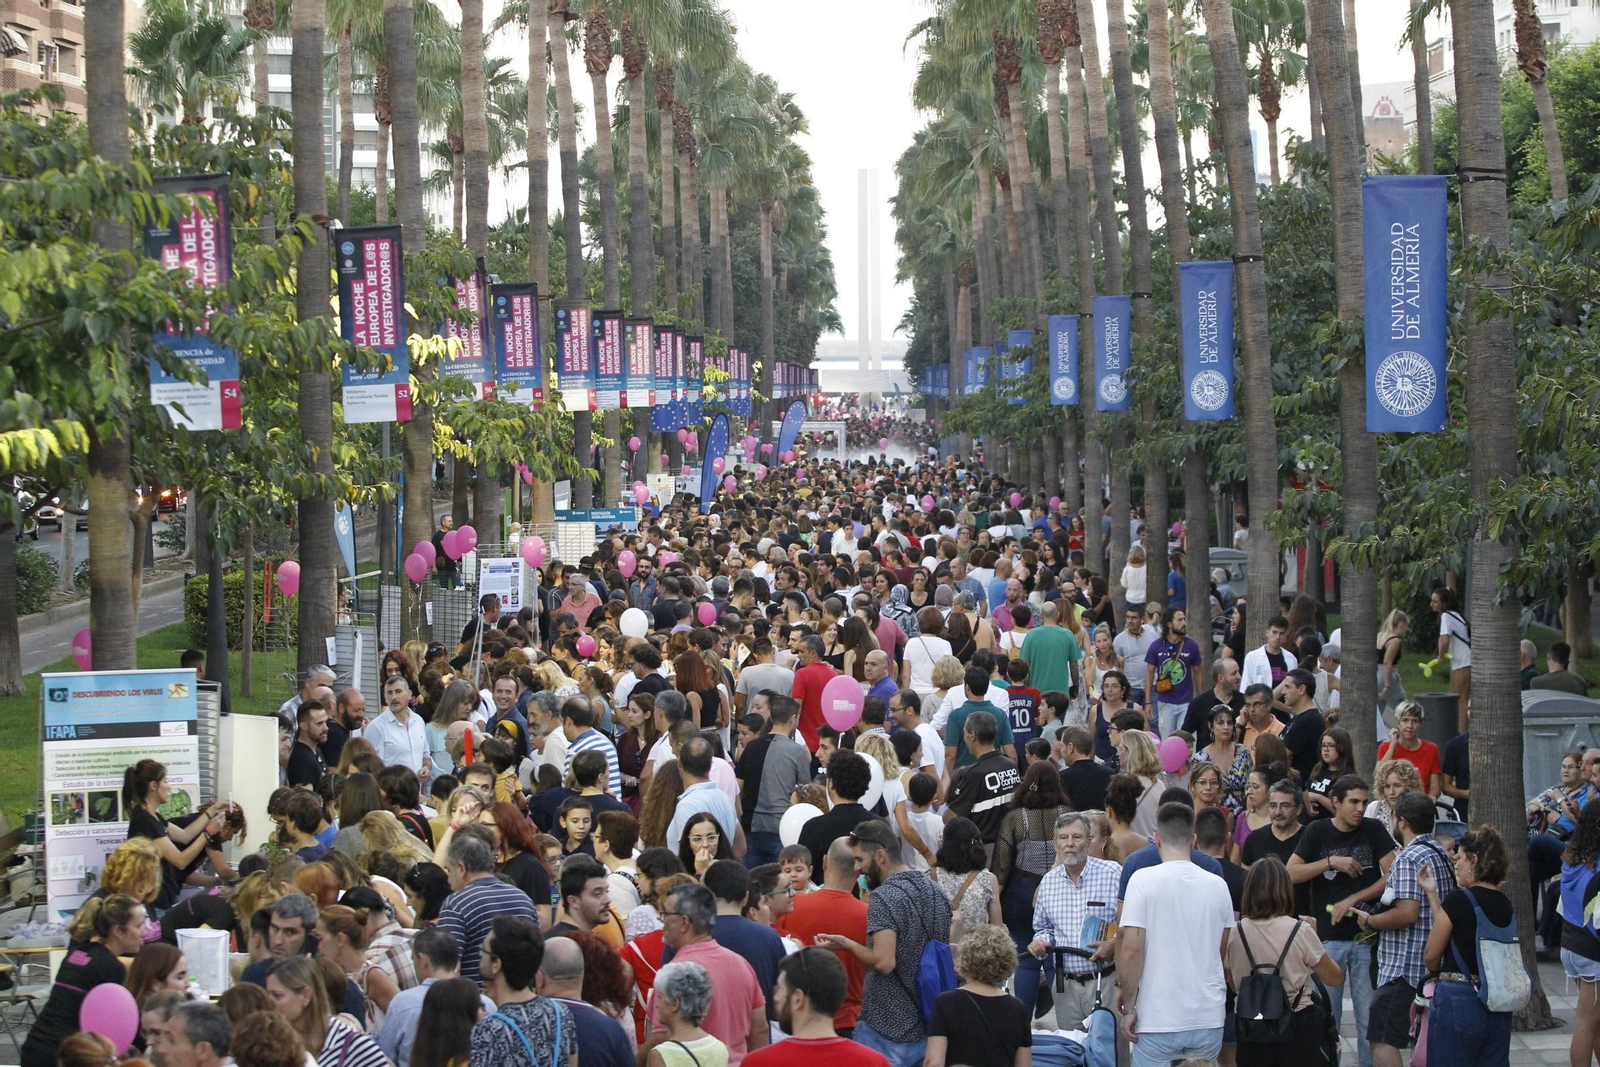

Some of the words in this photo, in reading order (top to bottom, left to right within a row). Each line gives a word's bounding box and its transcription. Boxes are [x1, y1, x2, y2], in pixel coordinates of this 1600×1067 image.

[366, 243, 376, 267] L@S
[1404, 223, 1419, 308] ALMERÍA
[367, 271, 377, 286] DE
[1391, 222, 1404, 339] UNIVERSIDAD
[379, 242, 395, 345] INVESTIGADOR@S
[354, 283, 365, 324] NOCHE
[369, 290, 380, 346] EUROPEA
[515, 314, 522, 326] DE
[1406, 314, 1420, 339] DE
[523, 297, 533, 366] INVESTIGADOR@S
[1198, 291, 1208, 364] UNIVERSIDAD
[355, 333, 367, 347] LA
[516, 329, 524, 367] EUROPEA
[507, 354, 514, 367] LA
[1113, 358, 1119, 369] DE
[1209, 347, 1218, 362] DE
[224, 389, 237, 398] 54
[72, 690, 126, 698] DESCUBRIENDO
[1012, 709, 1030, 727] 10
[46, 726, 76, 739] IFAPA
[998, 769, 1016, 780] grupo
